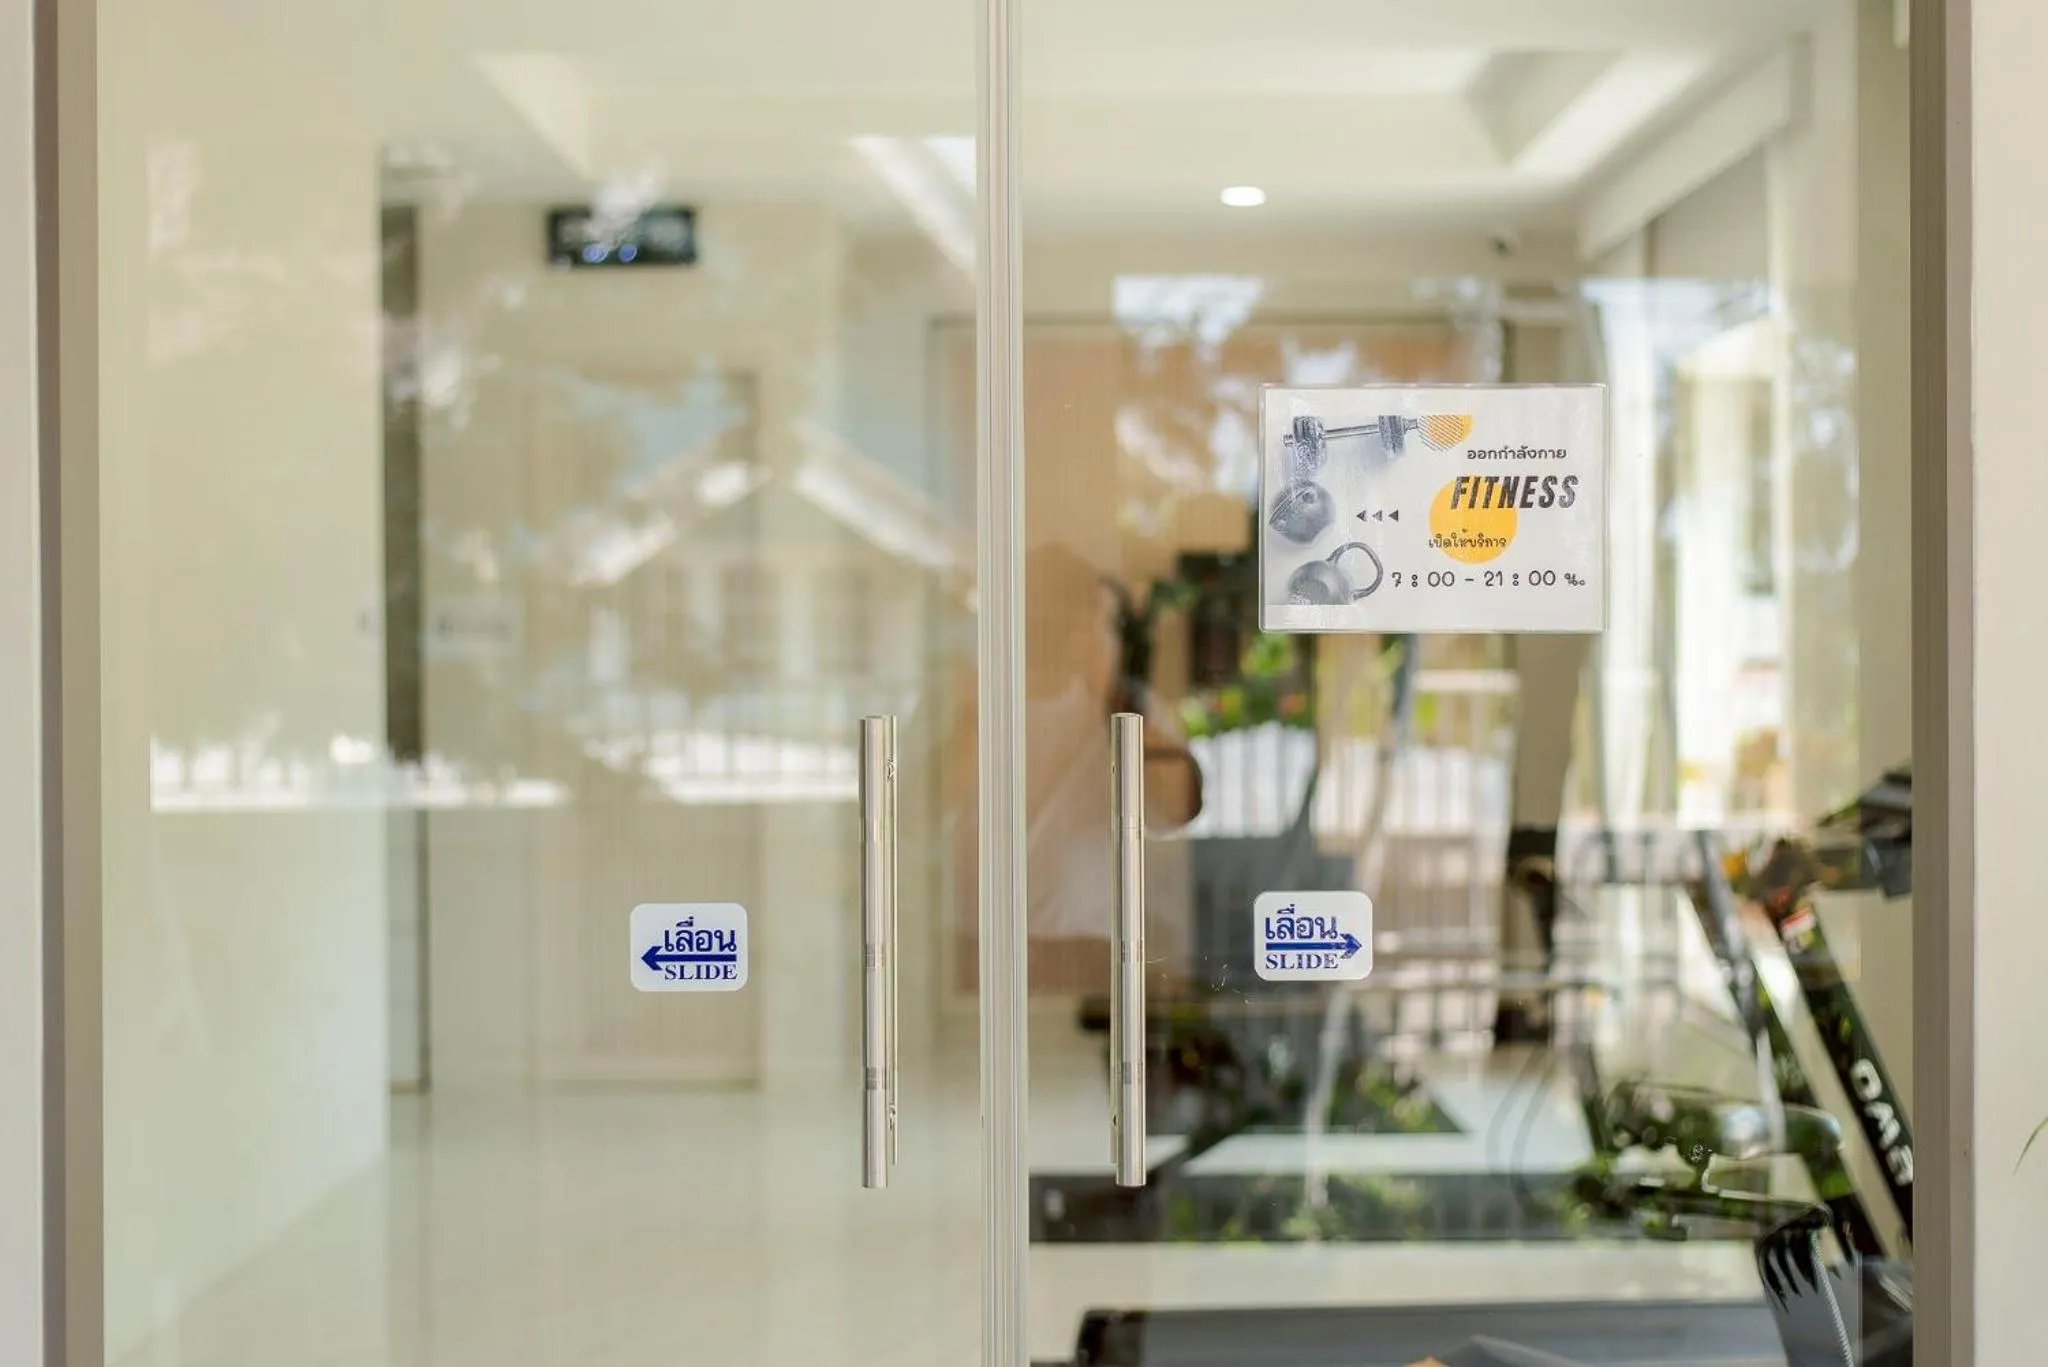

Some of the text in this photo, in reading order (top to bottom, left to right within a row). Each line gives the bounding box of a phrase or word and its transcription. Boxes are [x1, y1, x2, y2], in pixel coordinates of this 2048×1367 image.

[1467, 445, 1567, 460] ออกกำลังกาย
[1450, 475, 1579, 509] FITNESS
[1428, 528, 1507, 548] เปิดให้บริการ
[1483, 570, 1503, 586] 21
[1265, 904, 1338, 940] เลื่อน
[664, 916, 737, 952] เลื่อน
[1265, 953, 1339, 970] SLIDE
[664, 964, 738, 981] SLIDE
